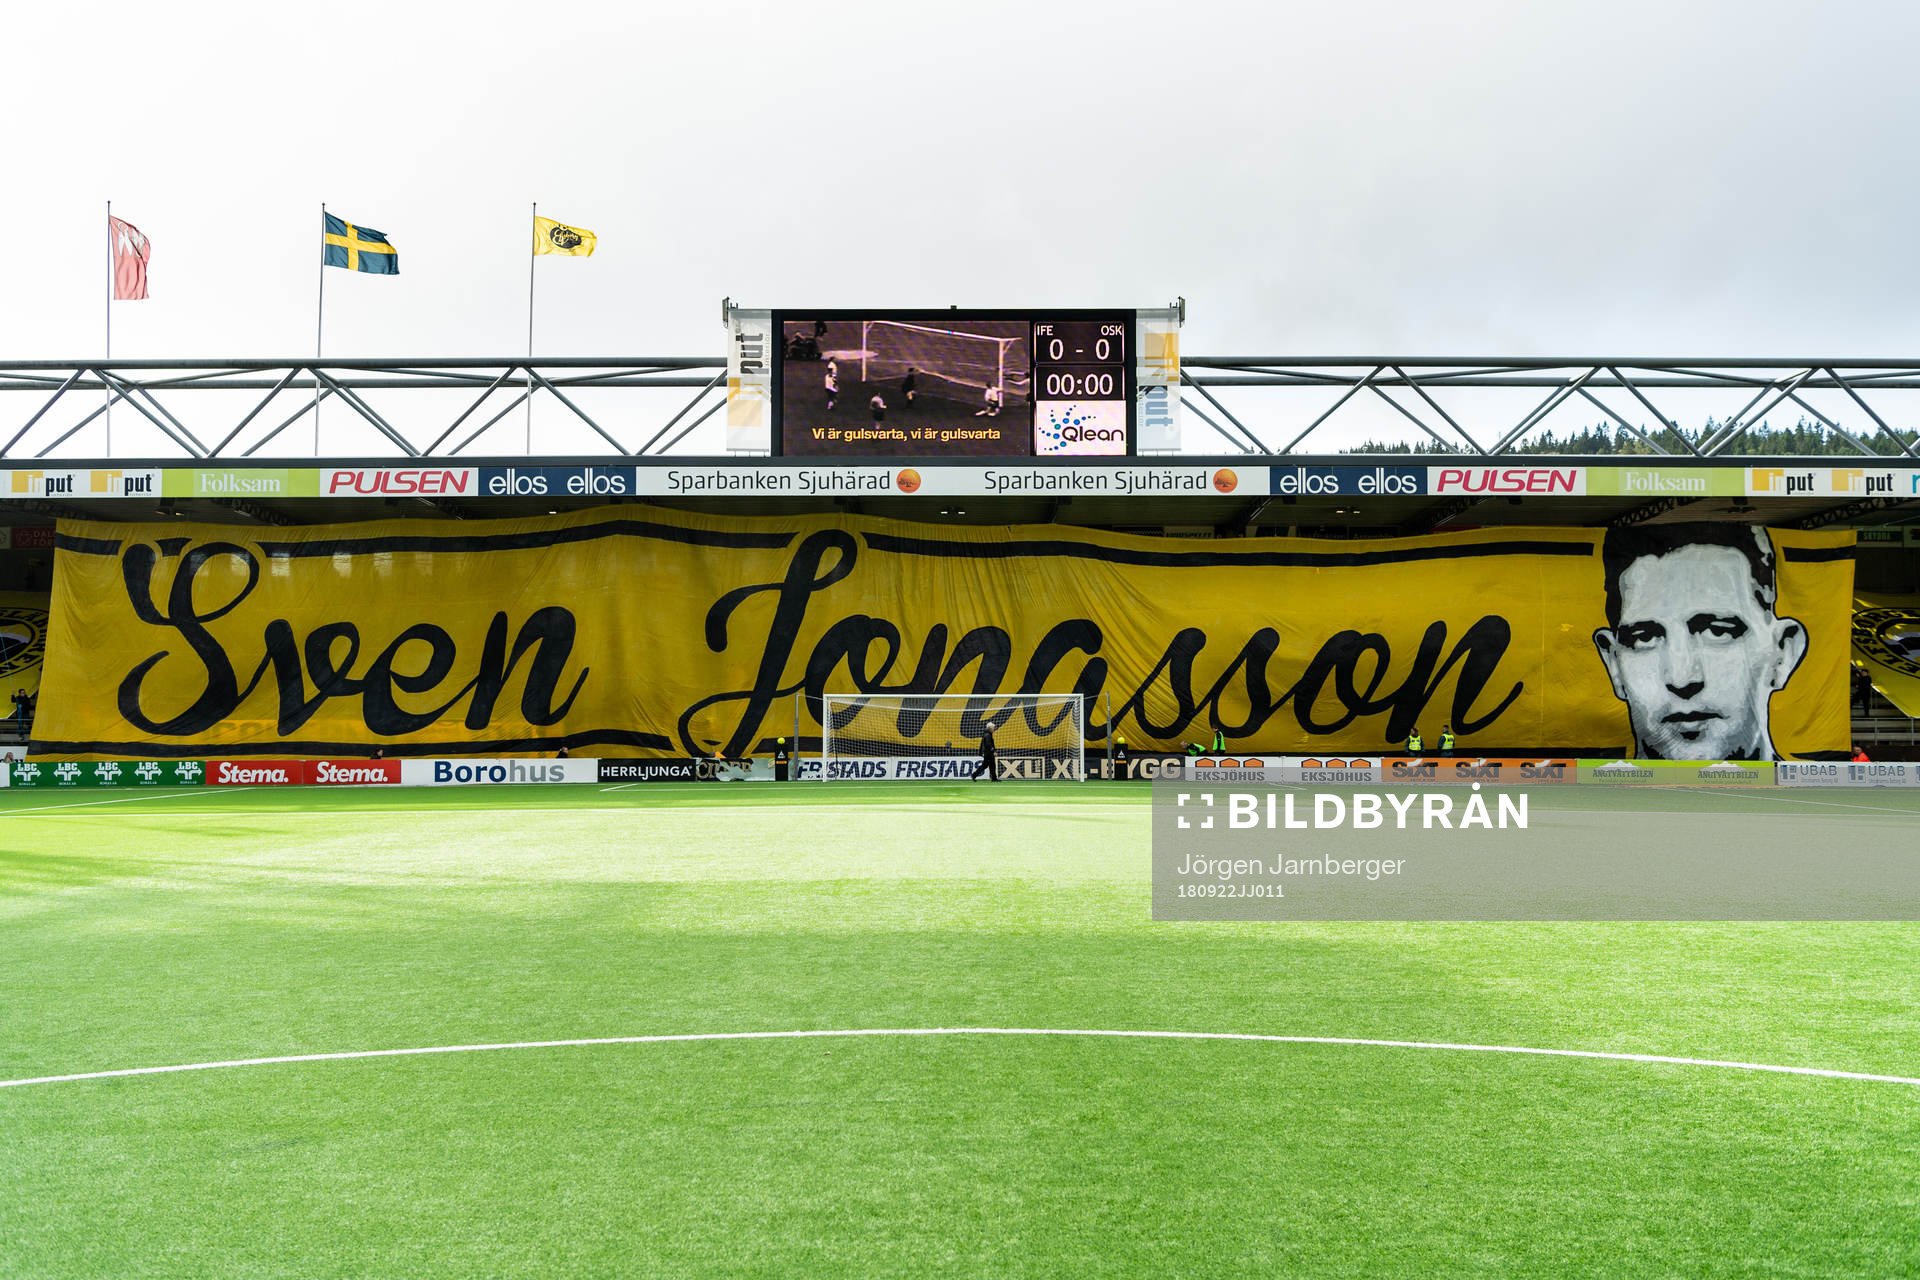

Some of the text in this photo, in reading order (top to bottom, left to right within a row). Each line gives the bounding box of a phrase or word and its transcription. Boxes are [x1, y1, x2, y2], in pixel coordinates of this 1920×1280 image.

[1037, 325, 1053, 336] IFE
[1101, 325, 1123, 336] OSK
[1049, 339, 1064, 360] 0
[1095, 339, 1110, 360] 0
[1047, 374, 1113, 395] 00:00
[812, 428, 1000, 442] Vi är gulsvarta, vi är gulsvarta
[1062, 426, 1124, 442] Qlean
[200, 472, 281, 493] Folksam
[329, 471, 469, 494] PULSEN
[488, 468, 548, 495] ellos
[567, 468, 626, 495] ellos
[667, 471, 890, 494] Sparbanken Sjuhärad
[984, 471, 1207, 494] Sparbanken Sjuhärad
[1279, 467, 1339, 494] ellos
[1358, 467, 1417, 494] ellos
[1437, 470, 1577, 492] PULSEN
[1625, 471, 1706, 491] Folksam
[118, 542, 589, 736] Sven
[678, 528, 1524, 758] Jonasson
[17, 763, 37, 771] LBC
[58, 763, 78, 771] LBC
[98, 762, 118, 771] LBC
[138, 762, 158, 770] LBC
[178, 761, 198, 770] LBC
[435, 760, 565, 782] Borohus
[1000, 759, 1041, 778] XL
[1195, 769, 1265, 781] EKSJÖHUS
[1302, 769, 1372, 782] EKSJÖHUS
[1800, 765, 1838, 776] UBAB
[1868, 765, 1906, 777] UBAB
